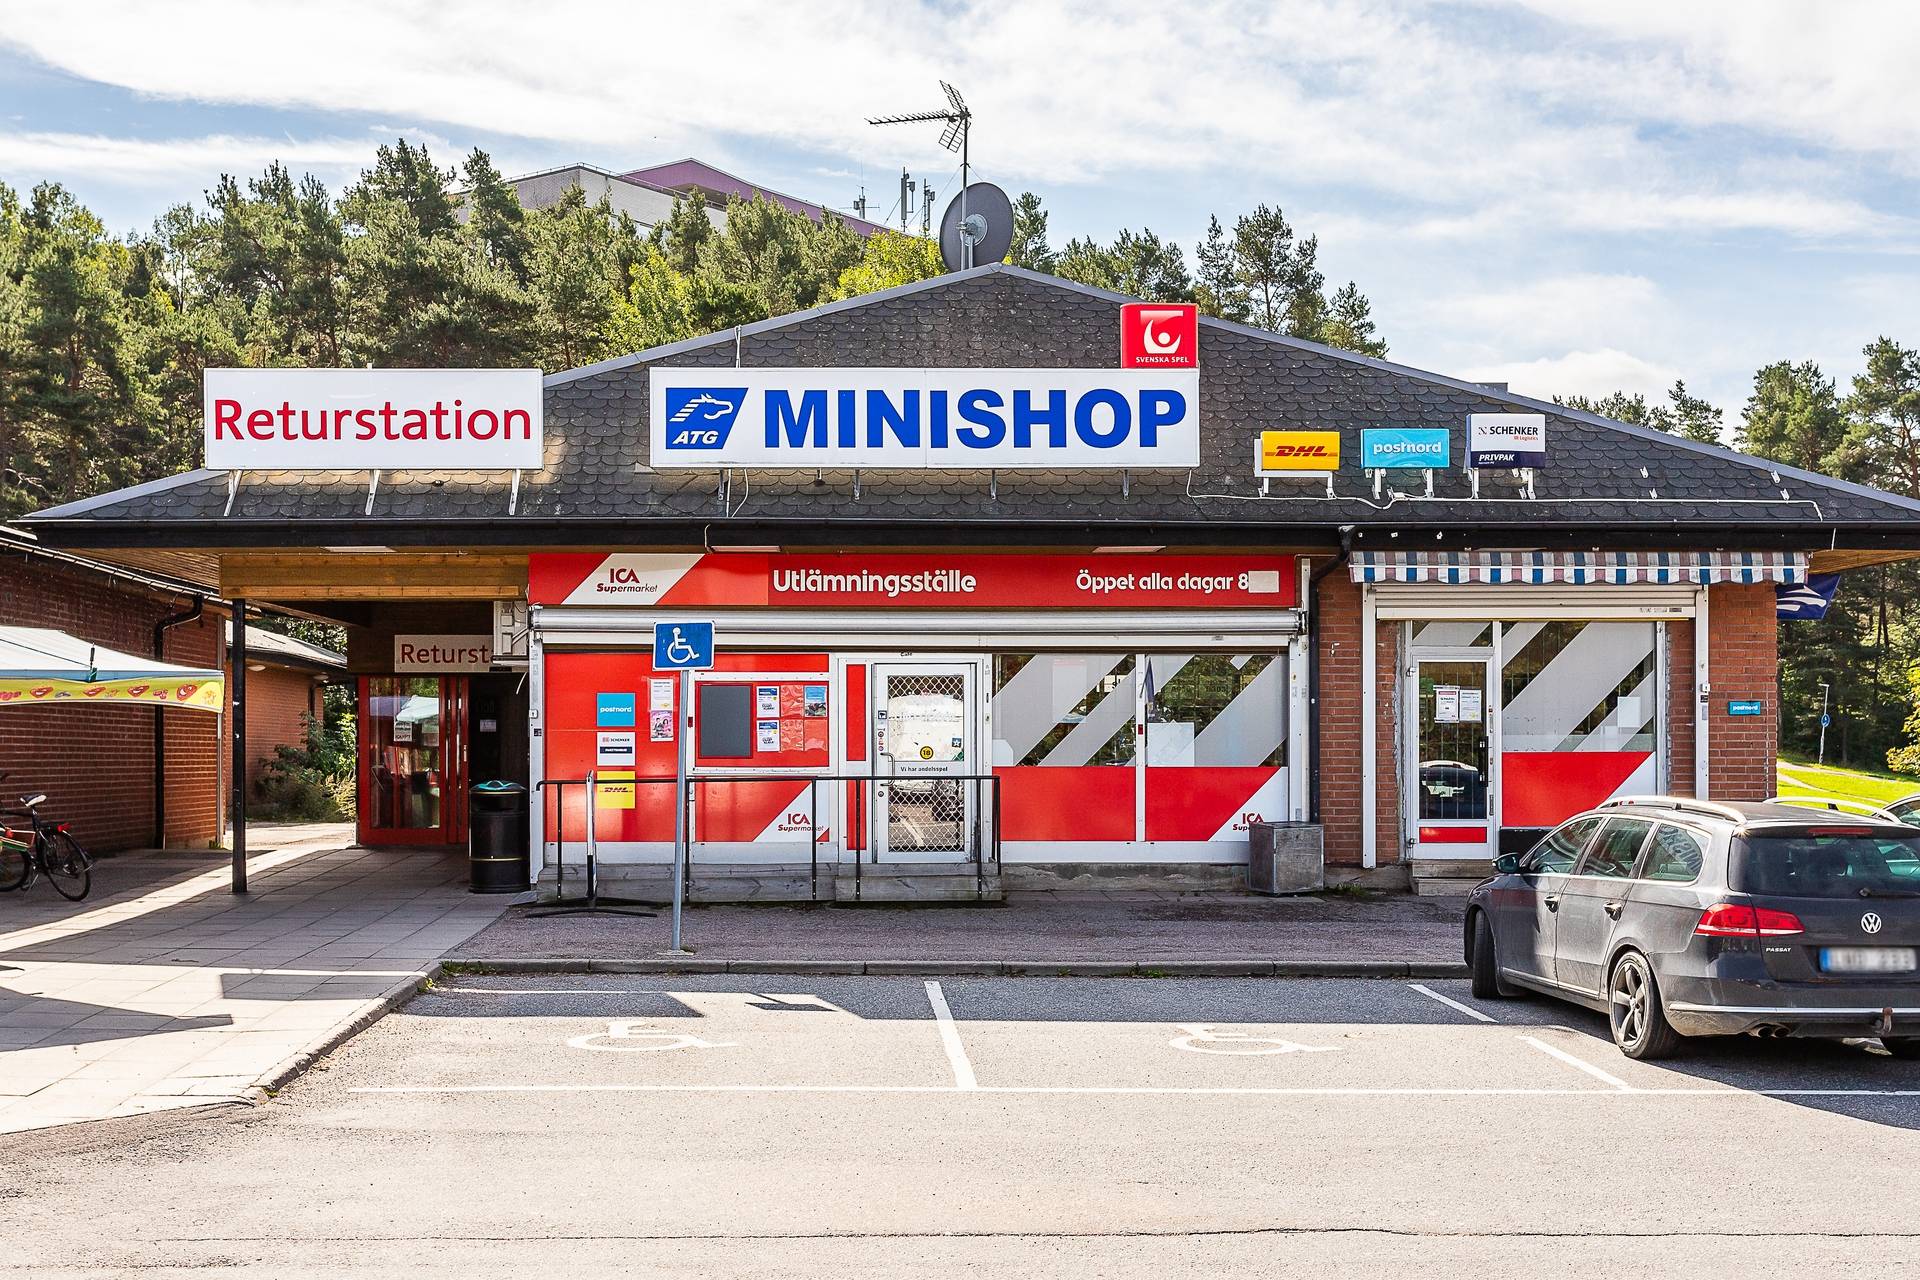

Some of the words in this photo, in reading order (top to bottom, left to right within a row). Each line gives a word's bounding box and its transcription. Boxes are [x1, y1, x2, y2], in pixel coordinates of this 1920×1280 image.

[214, 399, 531, 441] Returstation
[764, 388, 1187, 449] MINISHOP
[672, 430, 719, 445] ATG
[1489, 426, 1539, 436] SCHENKER
[1275, 445, 1328, 457] DHL
[1373, 441, 1442, 455] postnord
[1479, 453, 1514, 461] PRIVPAK
[610, 568, 640, 583] ICA
[1076, 569, 1135, 594] Öppet
[1138, 572, 1173, 590] alla
[1177, 572, 1233, 594] dagar
[596, 583, 658, 594] Supermarket
[773, 569, 977, 598] Utlämningsställe
[600, 705, 632, 713] postnord
[788, 813, 811, 825] ICA
[1242, 813, 1264, 824] ICA
